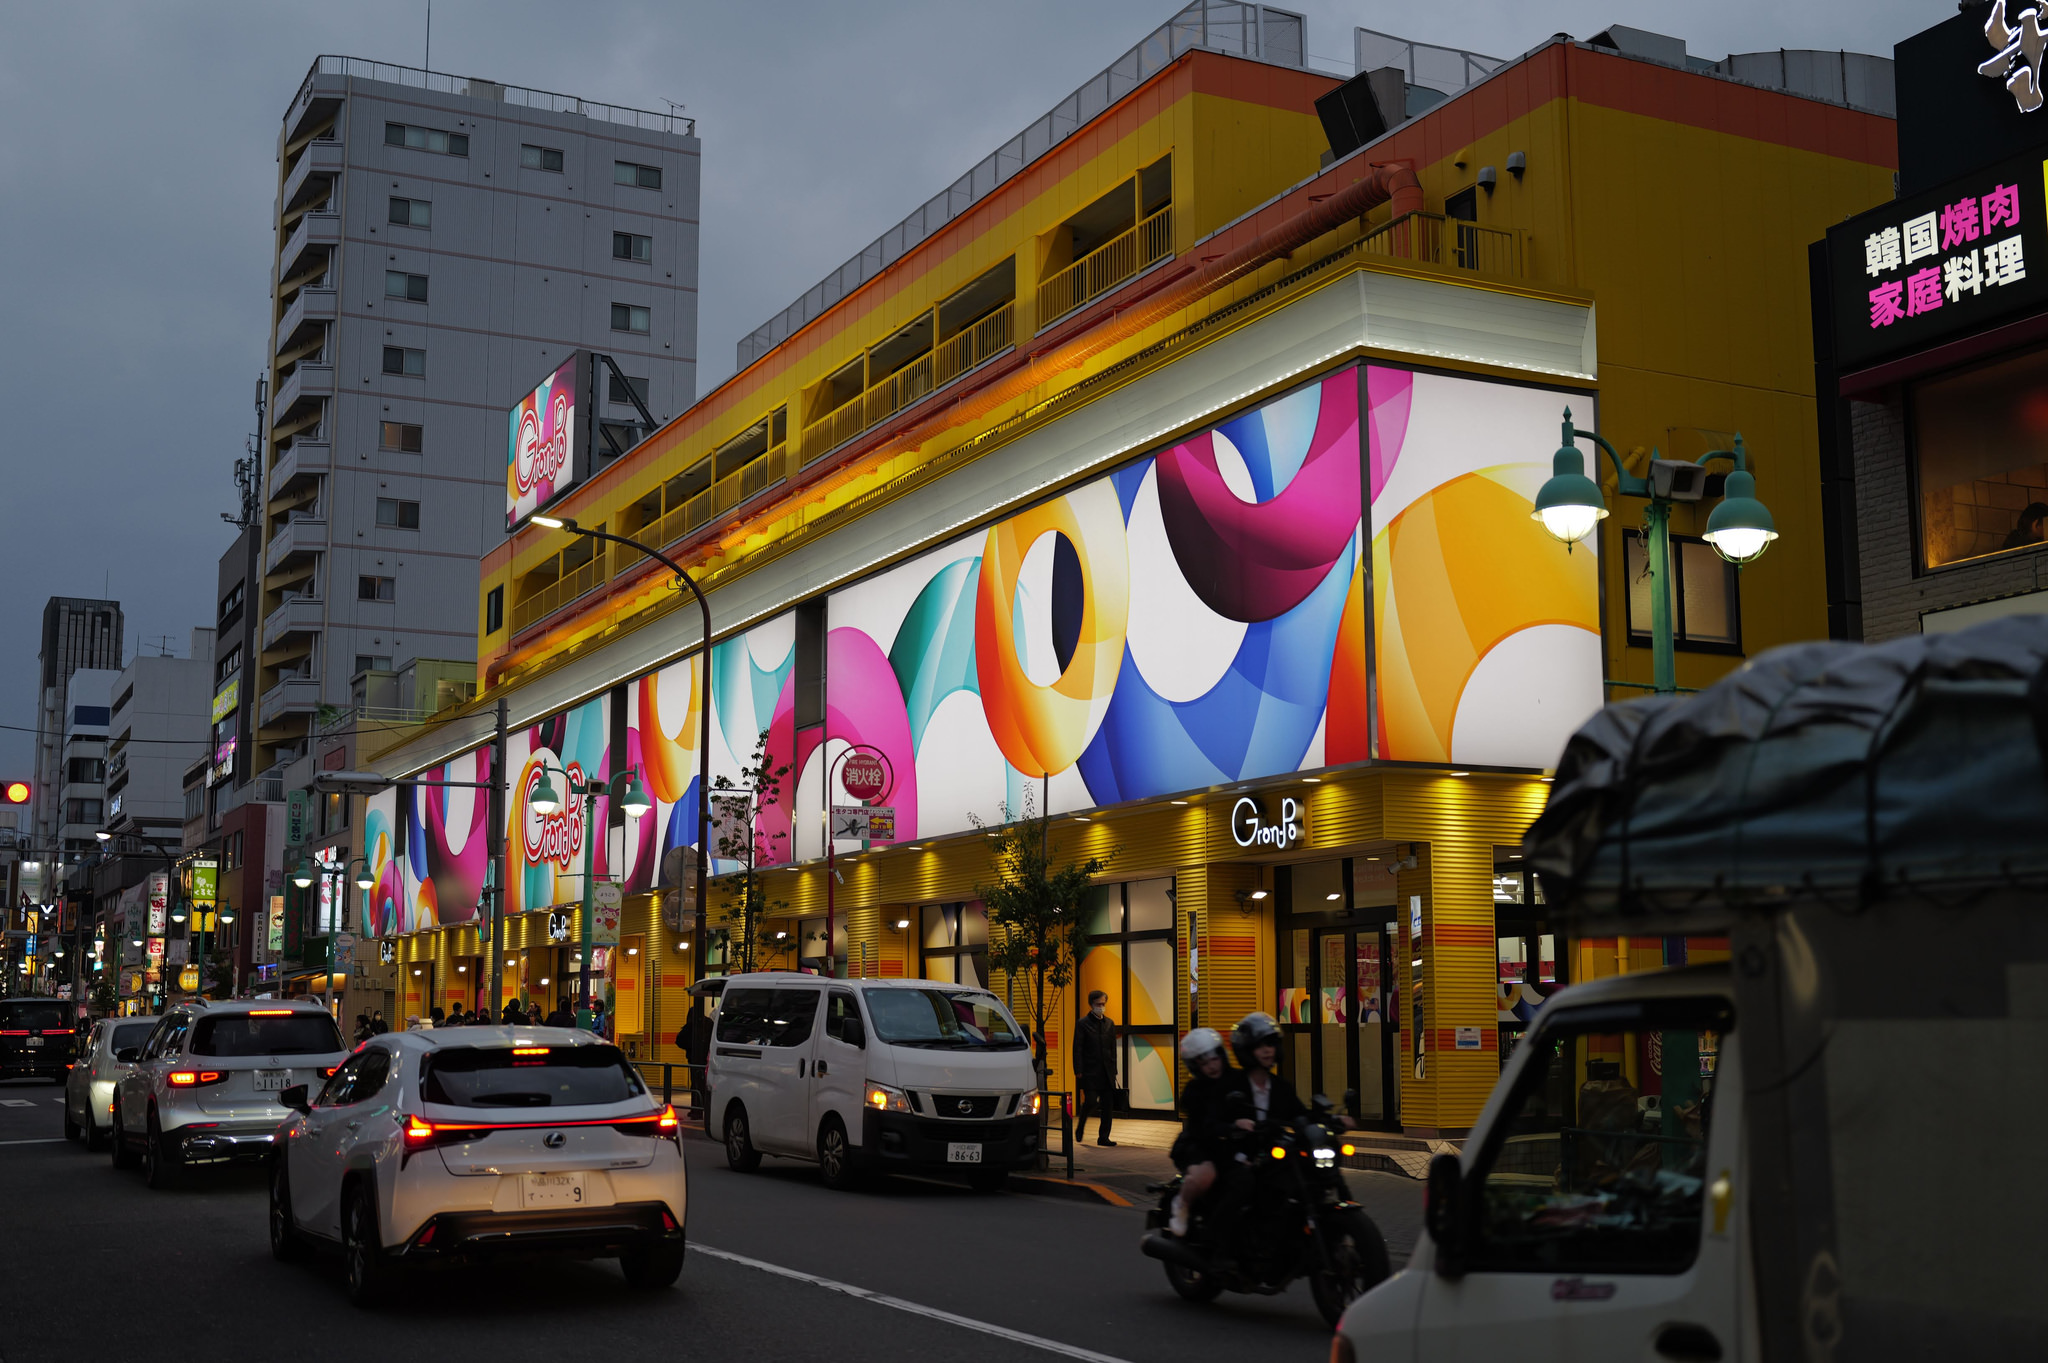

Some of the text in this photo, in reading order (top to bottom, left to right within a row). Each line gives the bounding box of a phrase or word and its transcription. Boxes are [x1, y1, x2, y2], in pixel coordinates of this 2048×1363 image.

[1864, 184, 2021, 278] 韓国焼肉
[1868, 234, 2027, 329] 家庭料理
[846, 768, 882, 786] 消火栓
[955, 1151, 980, 1161] 86-63
